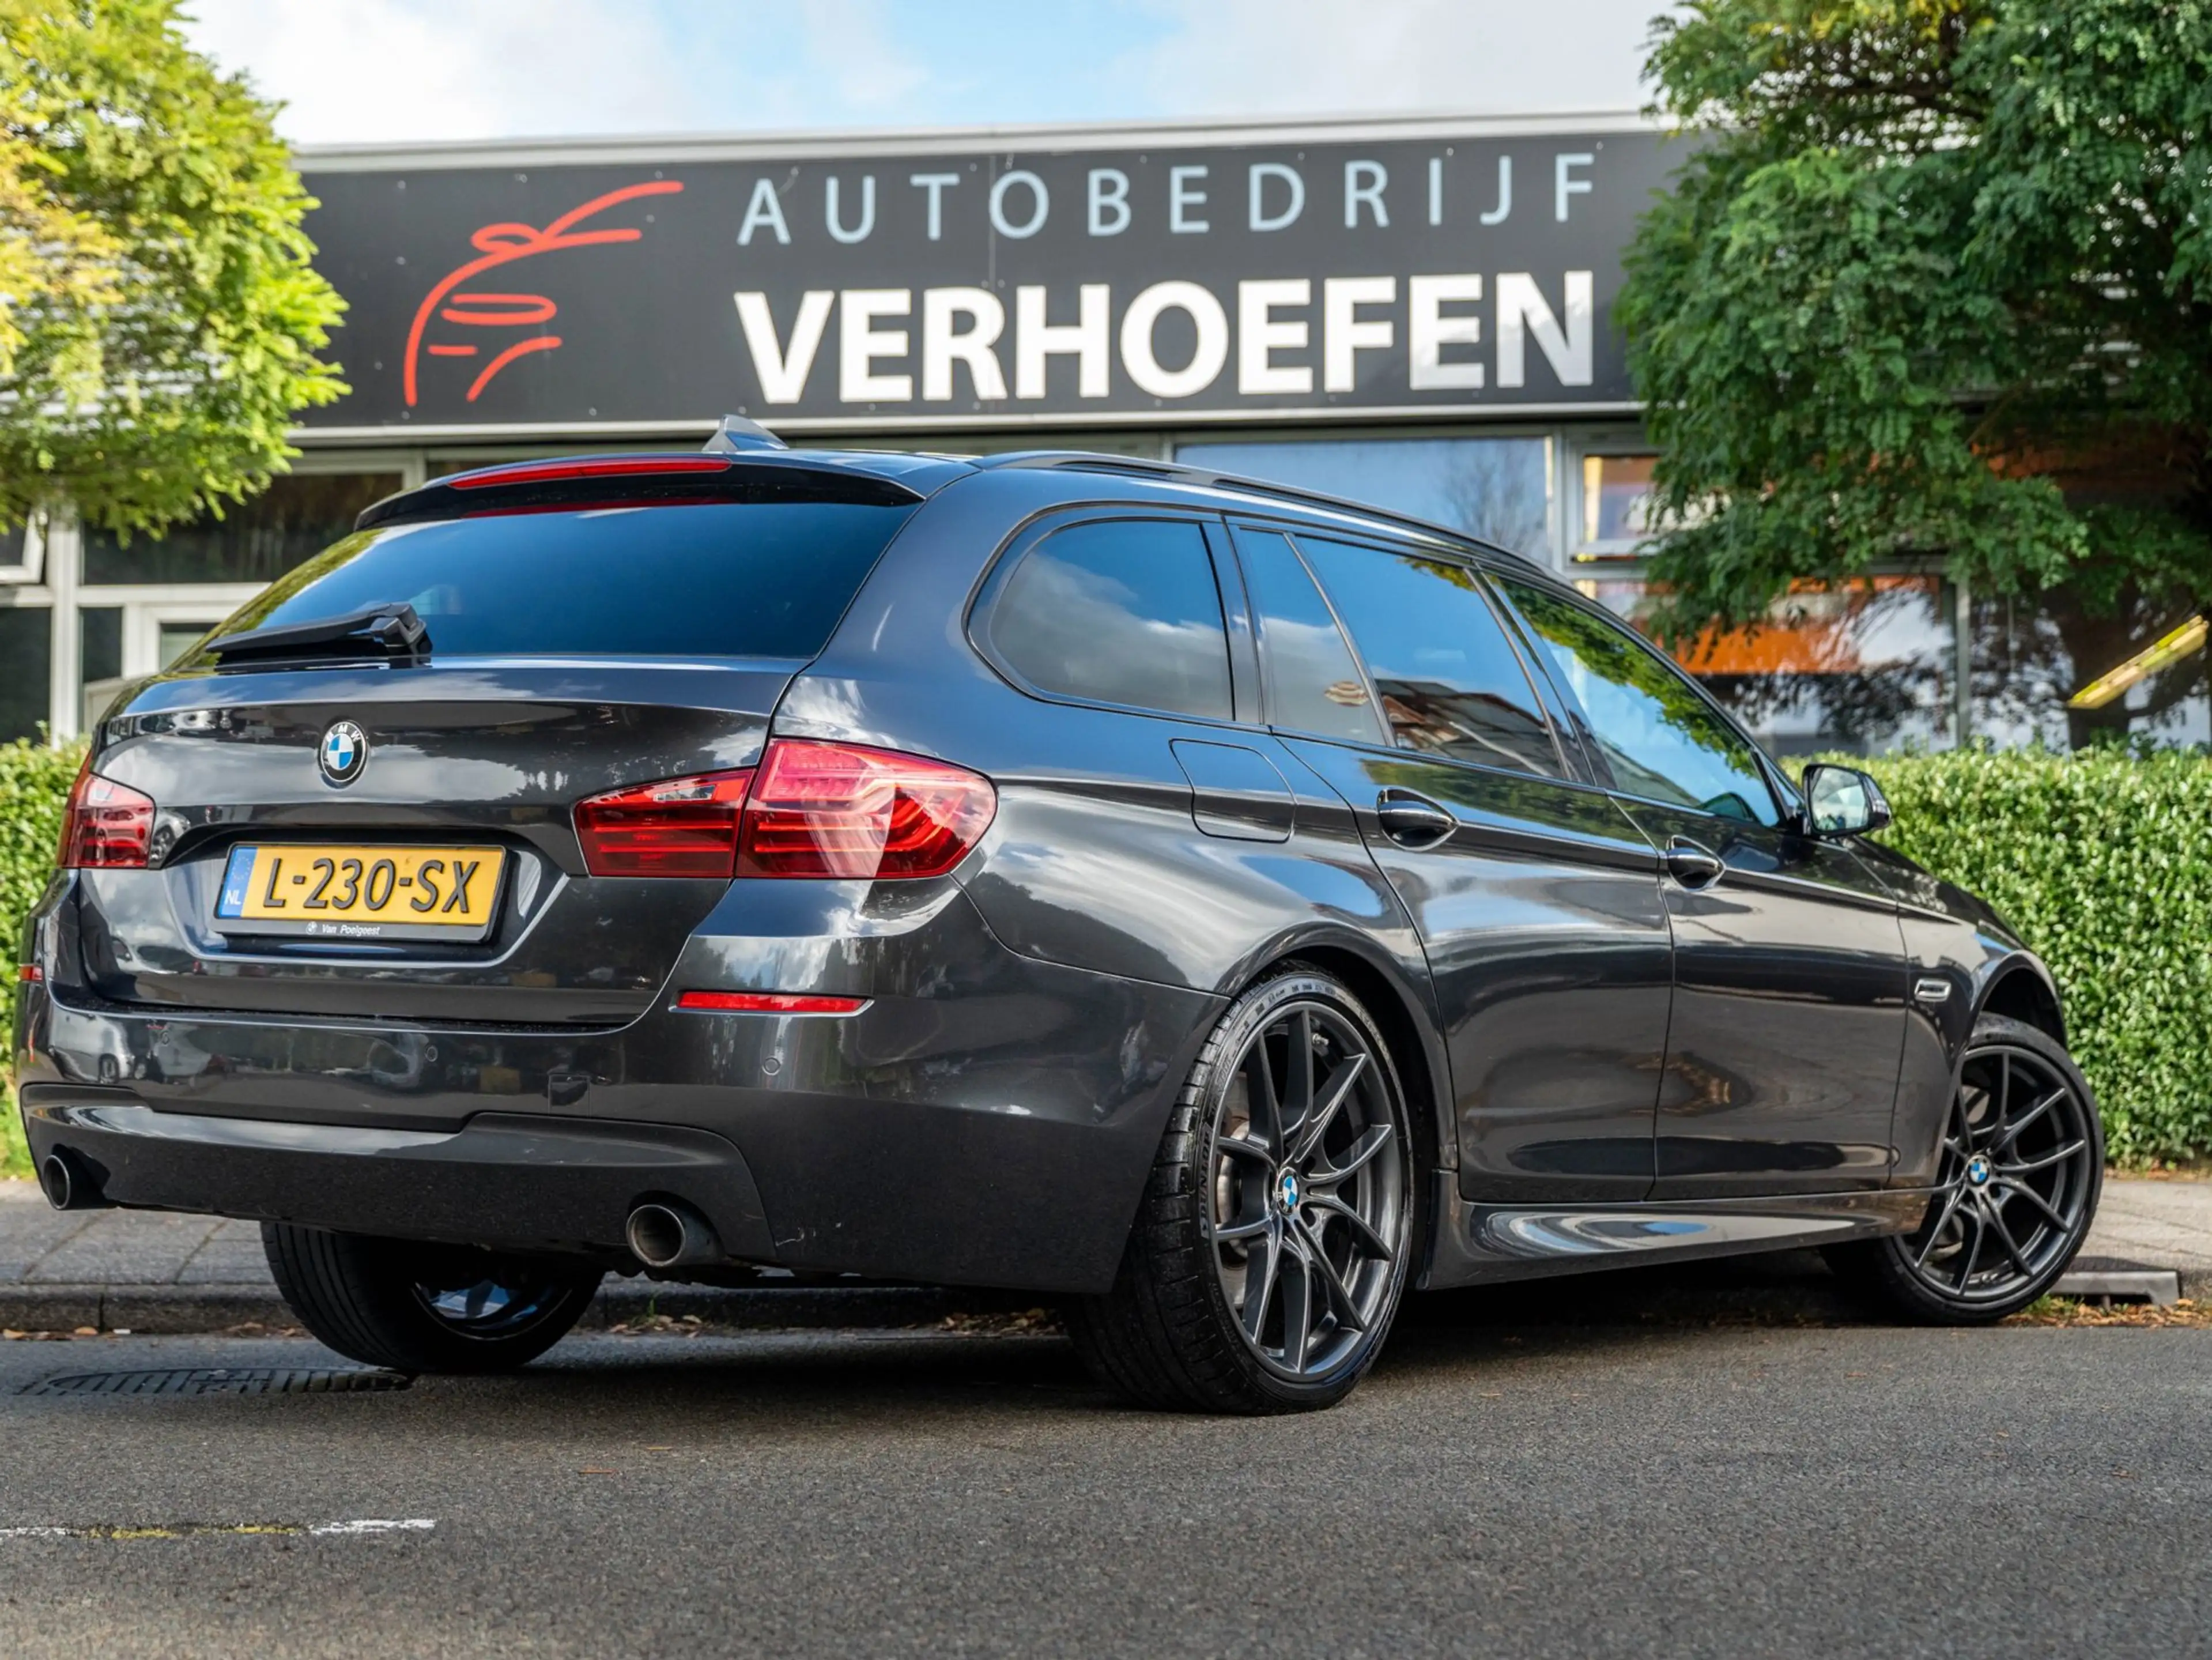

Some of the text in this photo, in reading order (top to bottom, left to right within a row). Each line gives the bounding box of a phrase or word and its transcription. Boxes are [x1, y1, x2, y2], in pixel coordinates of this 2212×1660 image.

[738, 153, 1595, 244] AUTOBEDRIJF
[734, 270, 1594, 403] VERHOEFEN
[225, 890, 242, 906] NL
[263, 858, 480, 914] L-230-SX
[323, 924, 337, 934] Van
